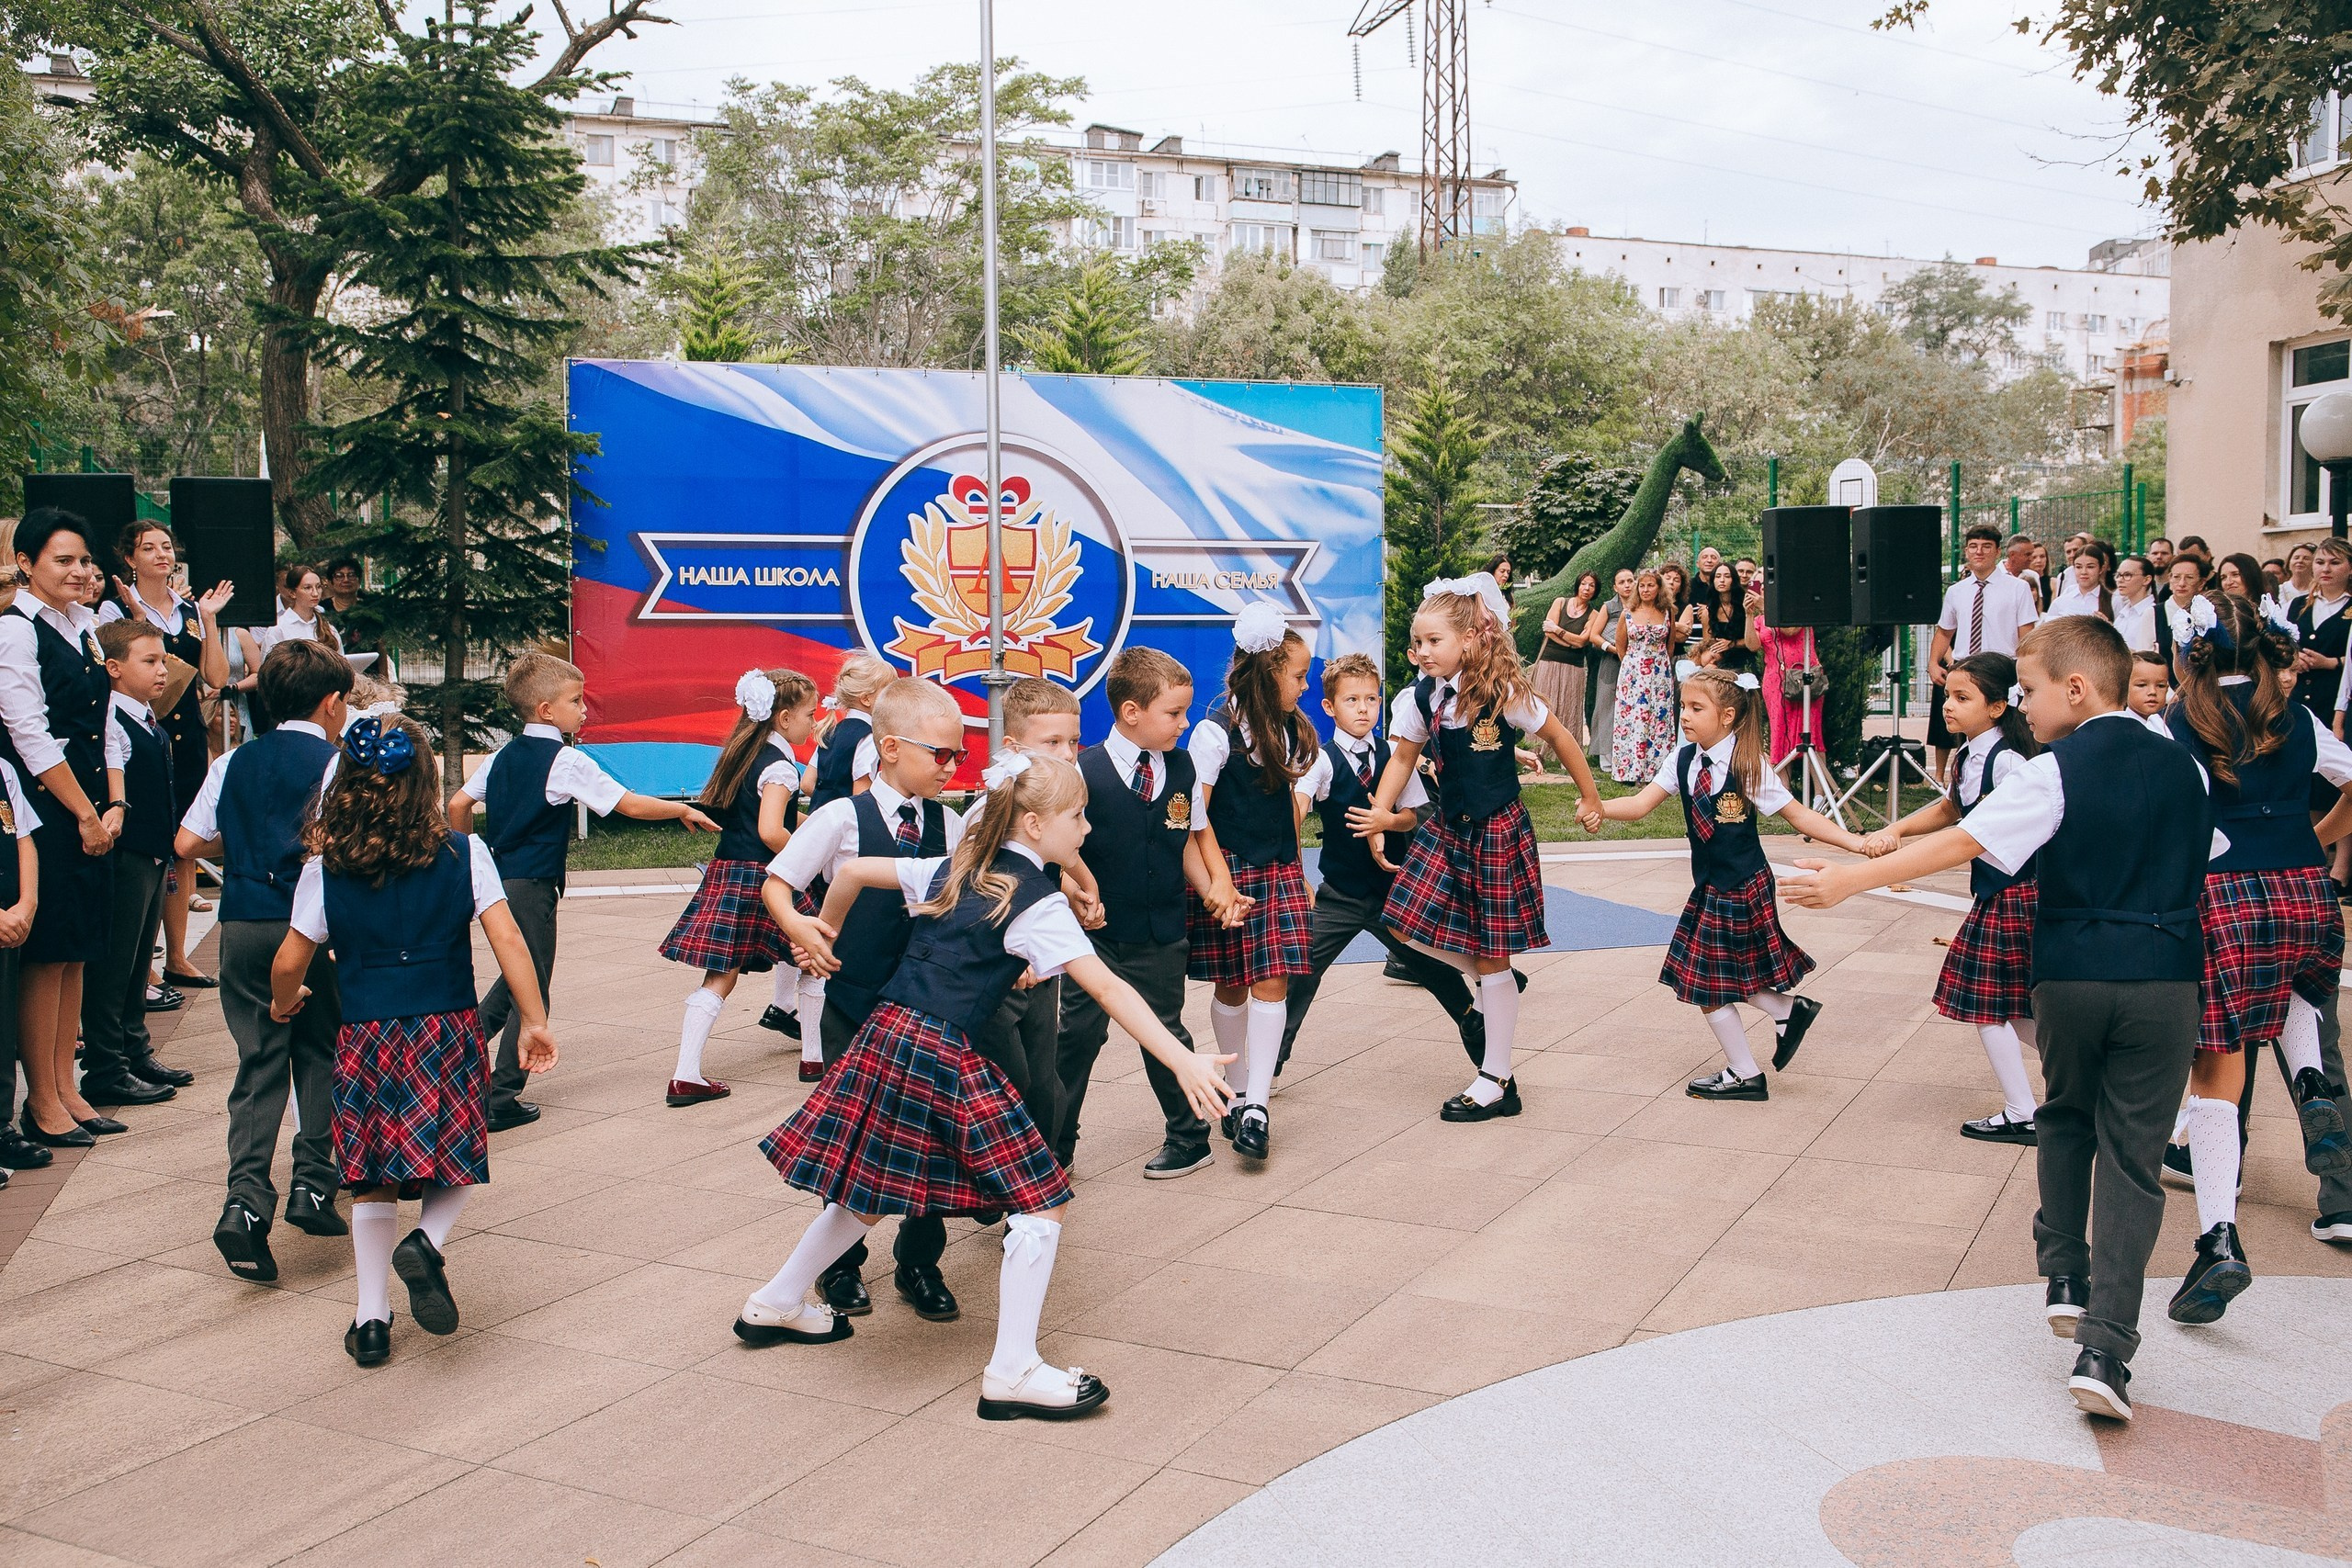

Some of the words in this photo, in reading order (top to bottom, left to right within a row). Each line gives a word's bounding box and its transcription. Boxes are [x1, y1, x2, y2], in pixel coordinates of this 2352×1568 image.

[679, 566, 751, 586] НАША
[754, 567, 841, 587] ШКОЛА
[1151, 571, 1210, 590] НАША
[1214, 571, 1278, 590] СЕМЬЯ
